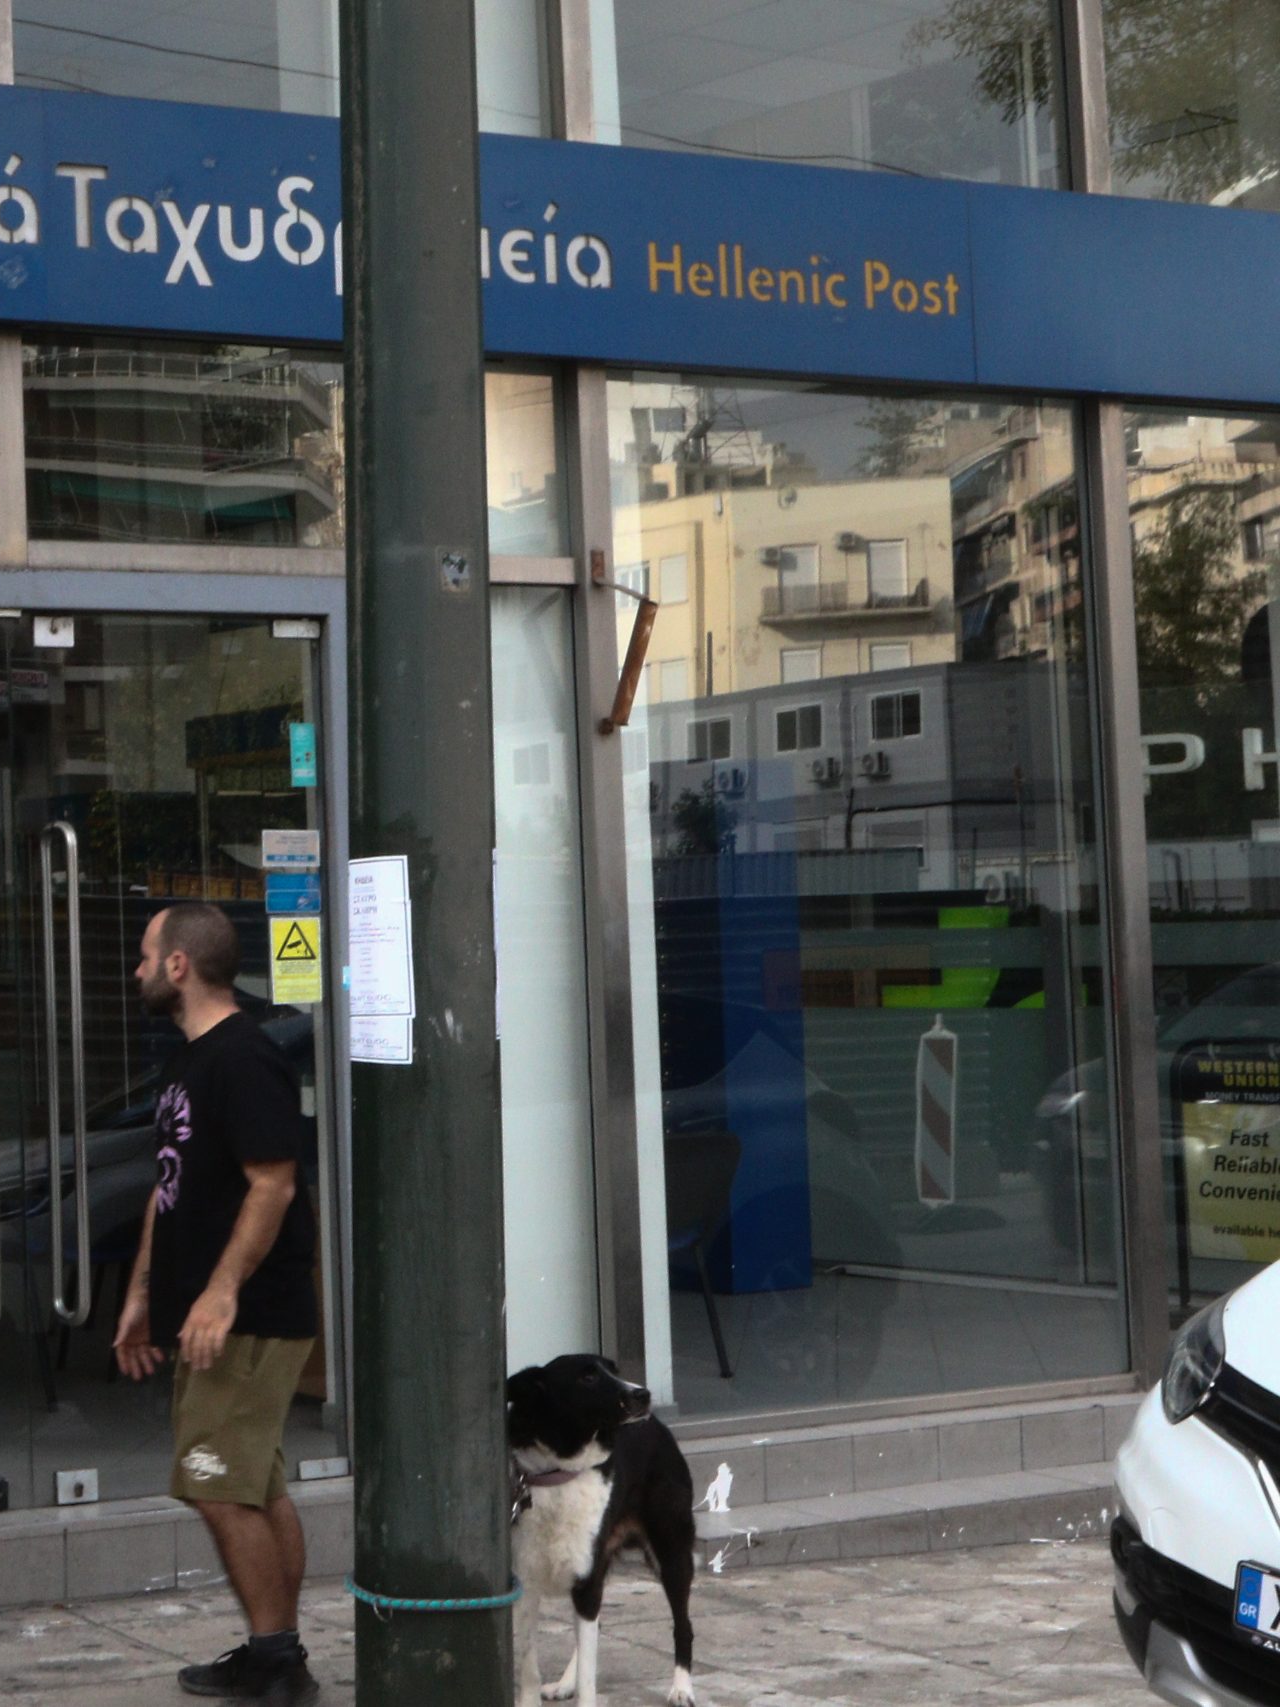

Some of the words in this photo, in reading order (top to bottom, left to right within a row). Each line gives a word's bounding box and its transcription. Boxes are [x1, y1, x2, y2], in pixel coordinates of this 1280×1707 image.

[55, 166, 613, 296] Ταχυδεία
[647, 241, 847, 309] Hellenic
[864, 260, 961, 316] Post
[1198, 1060, 1280, 1074] WESTERN
[1223, 1073, 1280, 1088] UNION
[1229, 1128, 1270, 1148] Fast
[1213, 1153, 1280, 1176] Reliabl
[1239, 1601, 1258, 1619] GR
